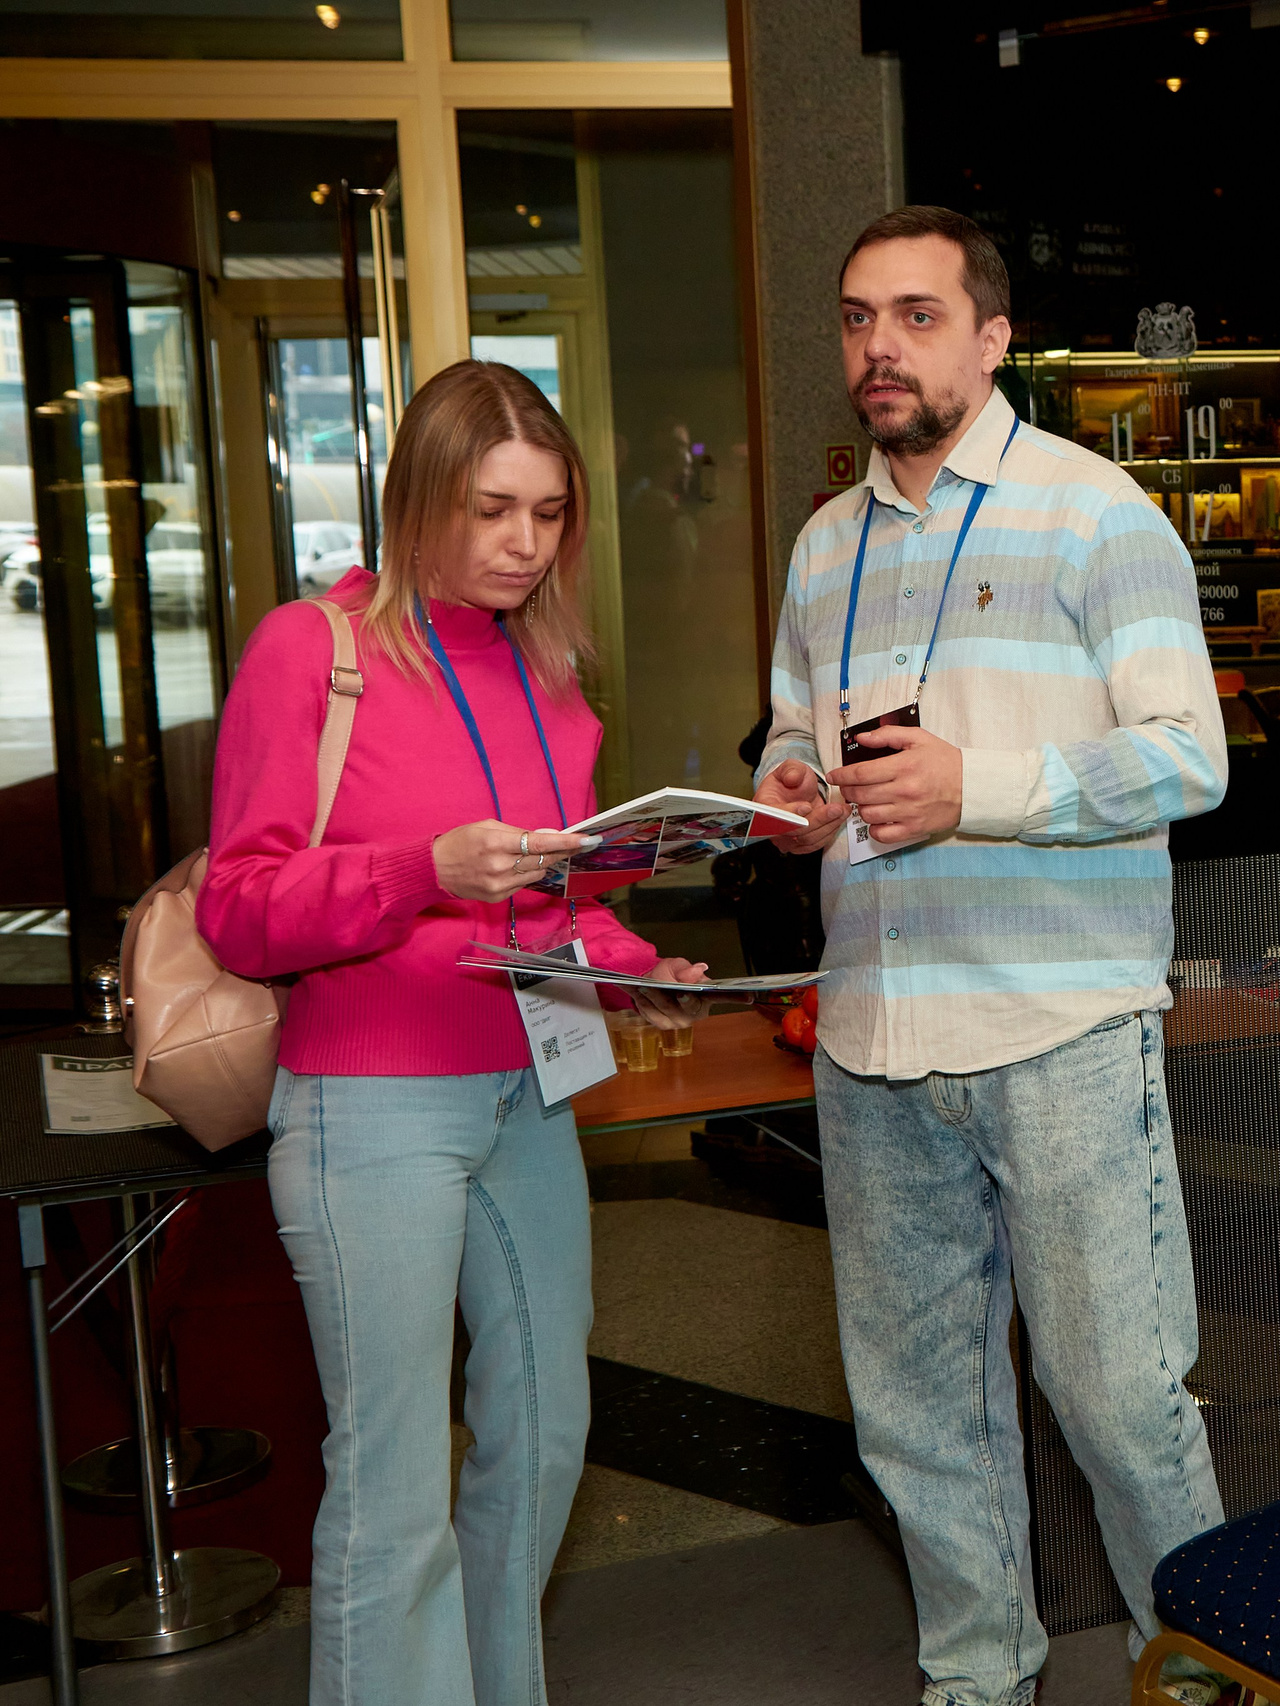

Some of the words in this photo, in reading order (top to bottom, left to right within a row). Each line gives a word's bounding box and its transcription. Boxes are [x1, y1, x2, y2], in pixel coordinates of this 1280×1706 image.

[1148, 381, 1191, 397] ПН-ПТ
[1185, 404, 1216, 461] 19
[1162, 468, 1182, 484] СБ
[1186, 489, 1215, 542] 17
[525, 998, 540, 1008] Анна
[527, 1000, 556, 1015] Макурина
